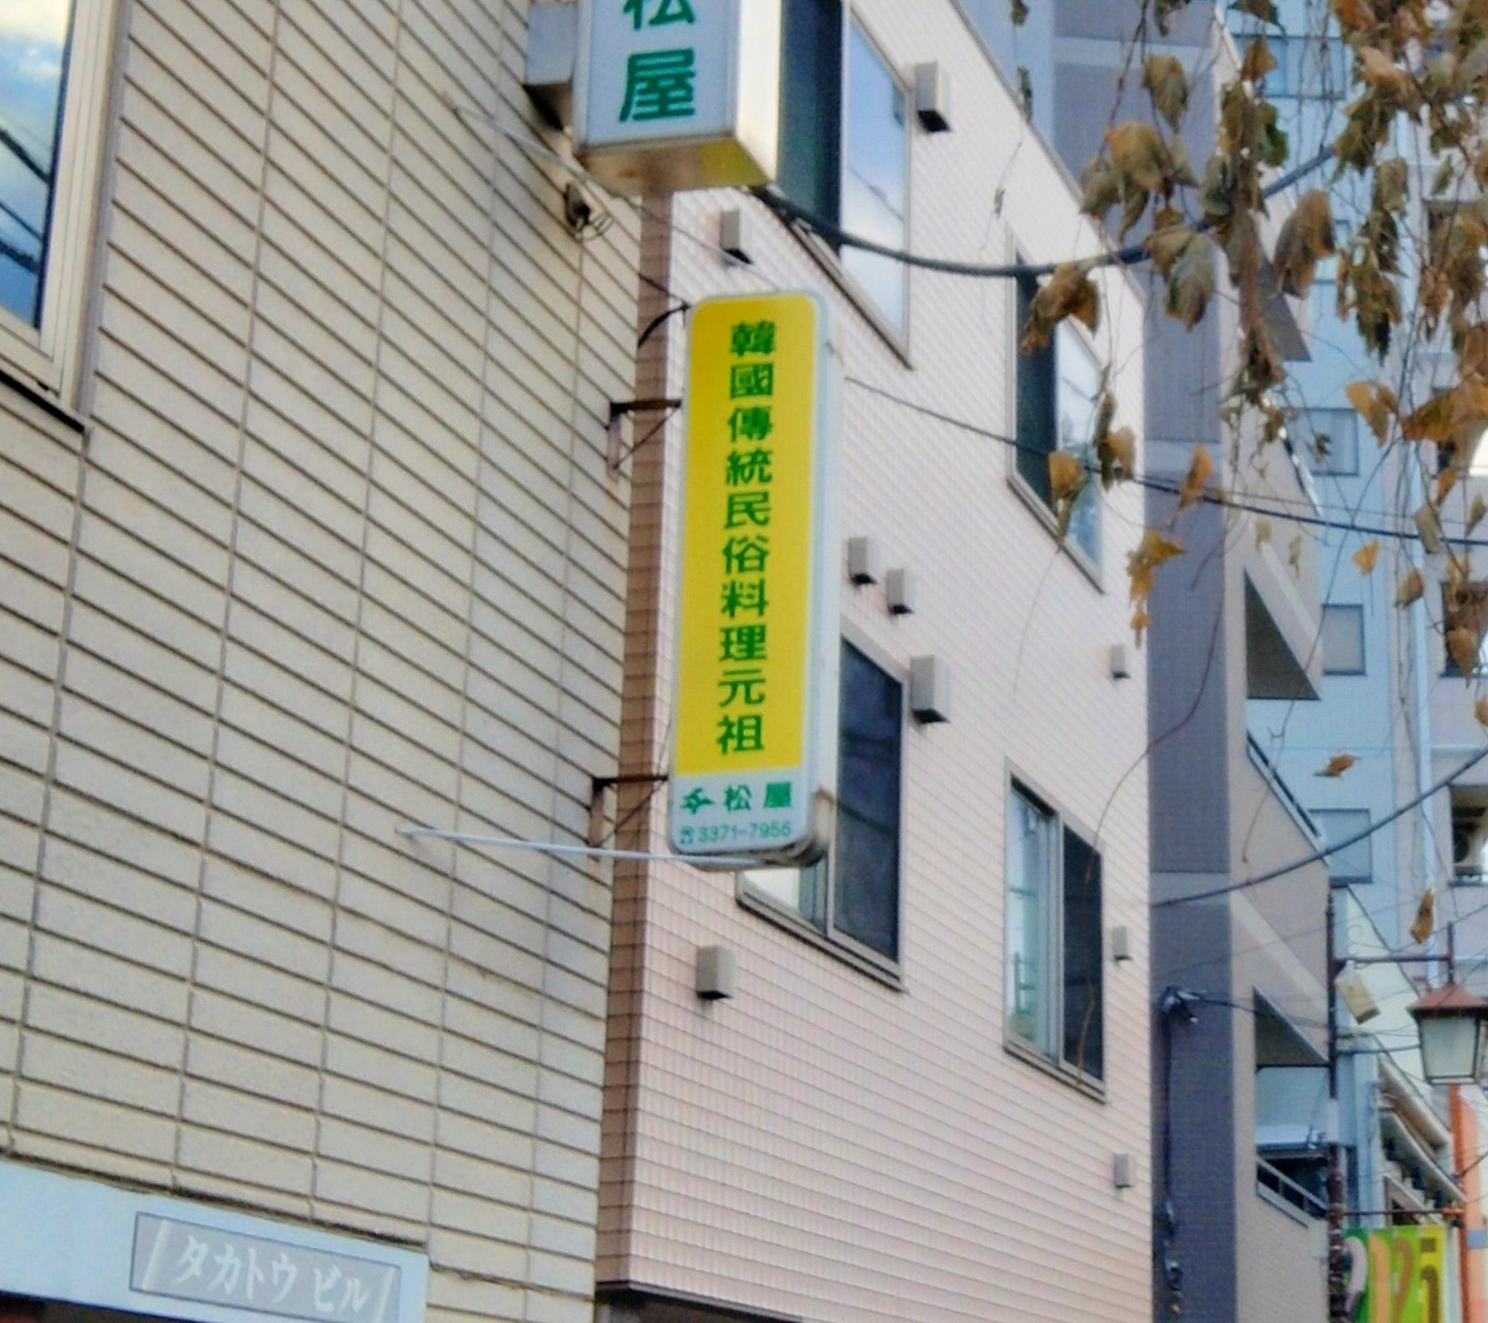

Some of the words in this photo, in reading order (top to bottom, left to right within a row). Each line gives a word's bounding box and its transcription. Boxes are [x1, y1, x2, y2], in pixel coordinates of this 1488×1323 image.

[172, 1234, 371, 1314] タカトウビル
